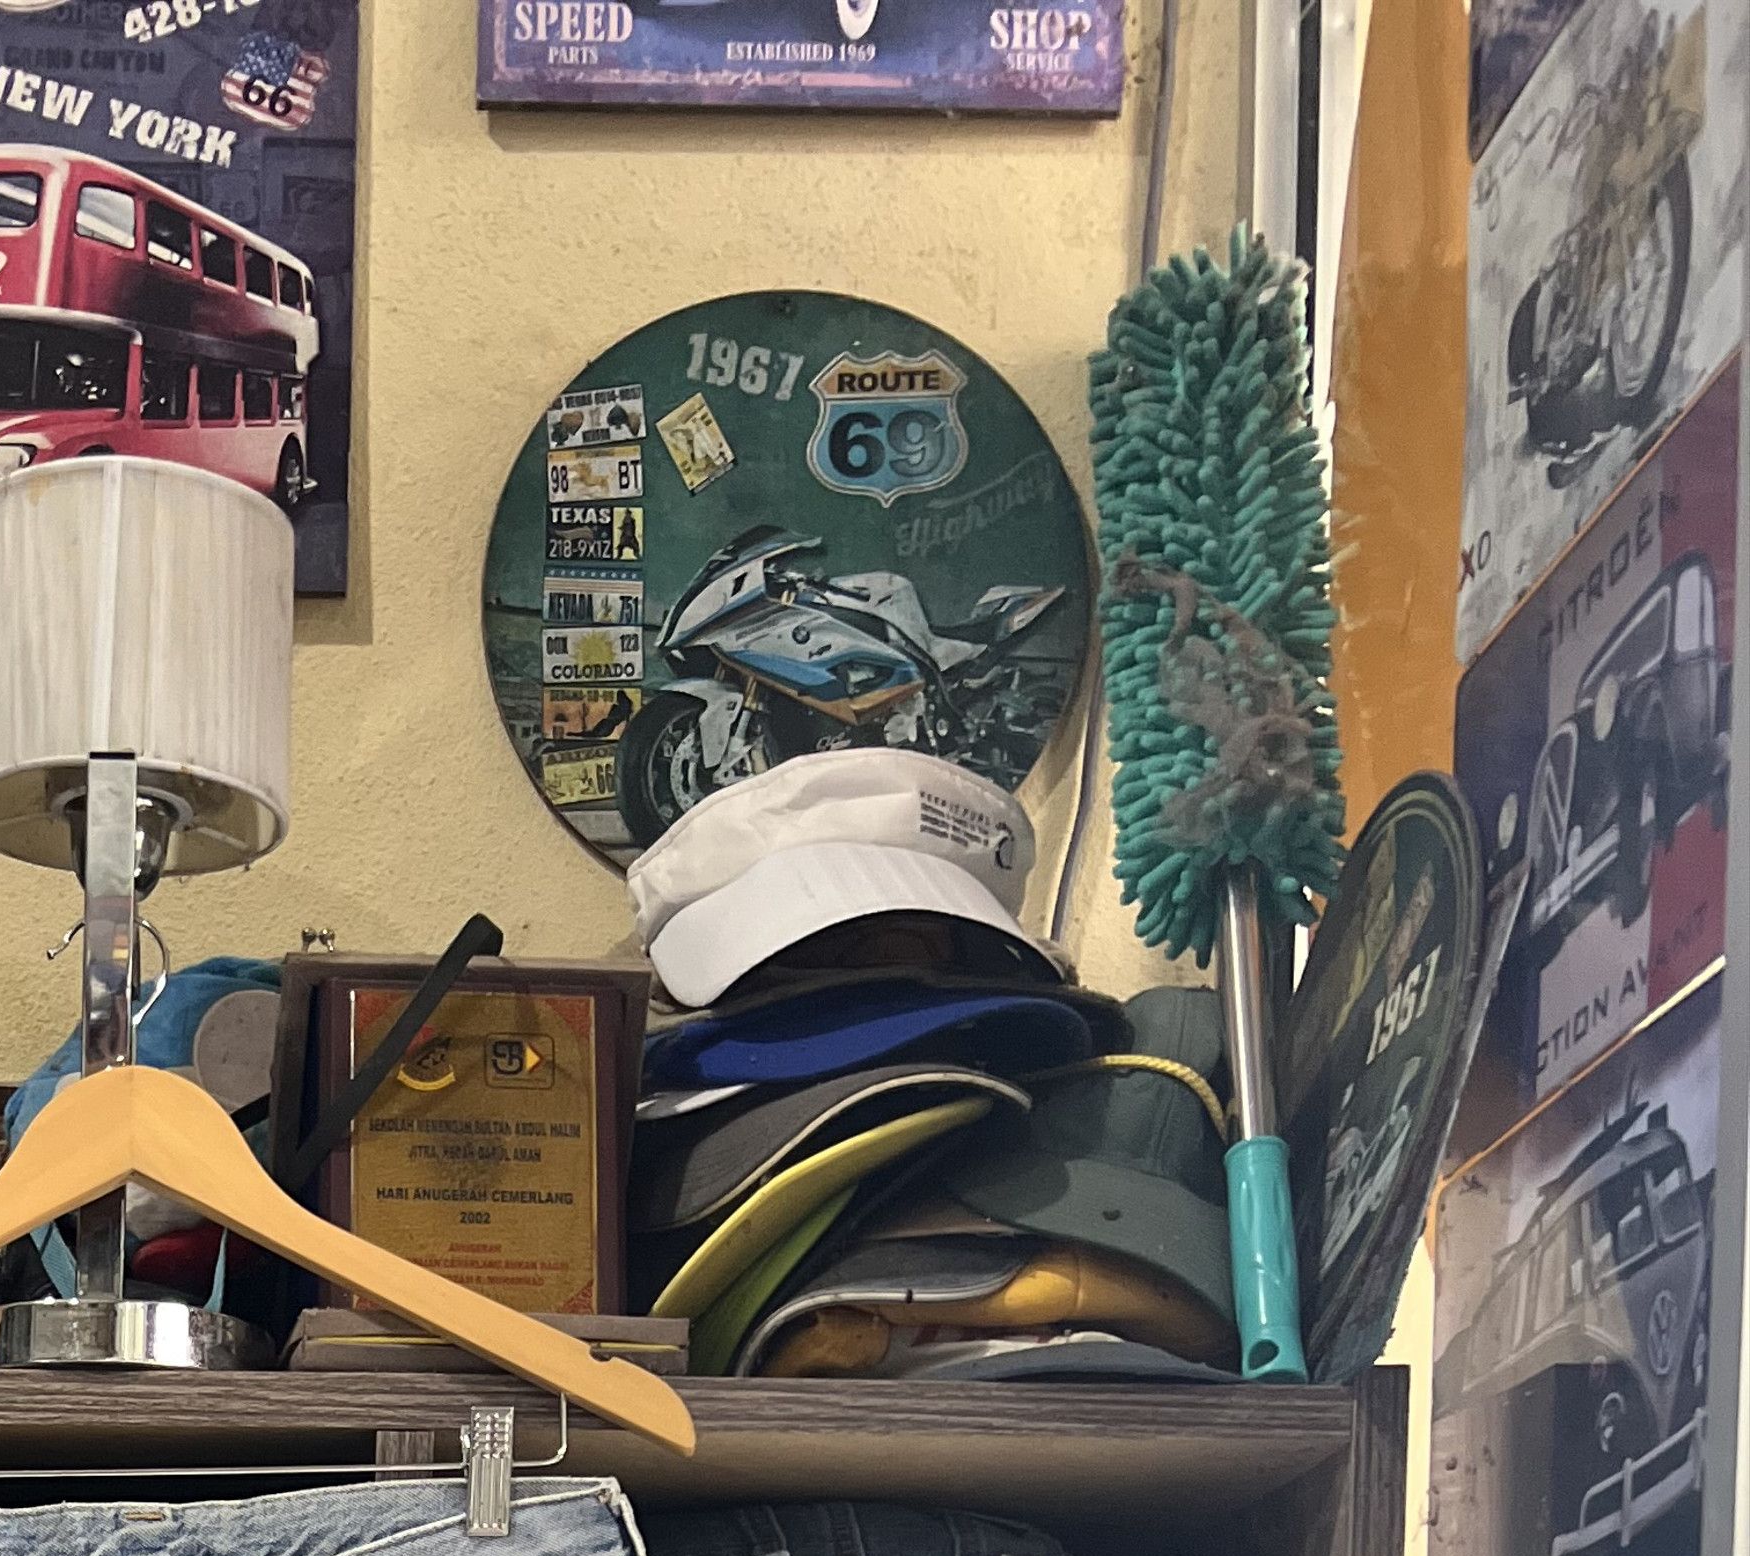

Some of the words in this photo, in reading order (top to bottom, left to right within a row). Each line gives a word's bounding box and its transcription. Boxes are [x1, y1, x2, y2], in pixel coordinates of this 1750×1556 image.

[514, 1, 633, 43] SPEED
[990, 9, 1091, 51] SHOP
[549, 46, 598, 64] PARTS
[726, 40, 833, 62] ESTABLISHED
[838, 43, 877, 62] 1969
[1006, 52, 1072, 71] SERVICE
[242, 76, 298, 117] 66
[107, 99, 239, 169] YORK
[686, 333, 804, 401] 1967
[837, 370, 940, 392] ROUTE
[828, 409, 946, 478] 69
[551, 465, 569, 493] 98
[551, 507, 611, 524] TEXAS
[551, 662, 636, 680] COLORADO
[1366, 944, 1442, 1065] 1967
[376, 1187, 408, 1200] HARI
[413, 1188, 487, 1202] ANUGERAH
[492, 1190, 574, 1205] CEMERLANG
[460, 1212, 490, 1224] 2002
